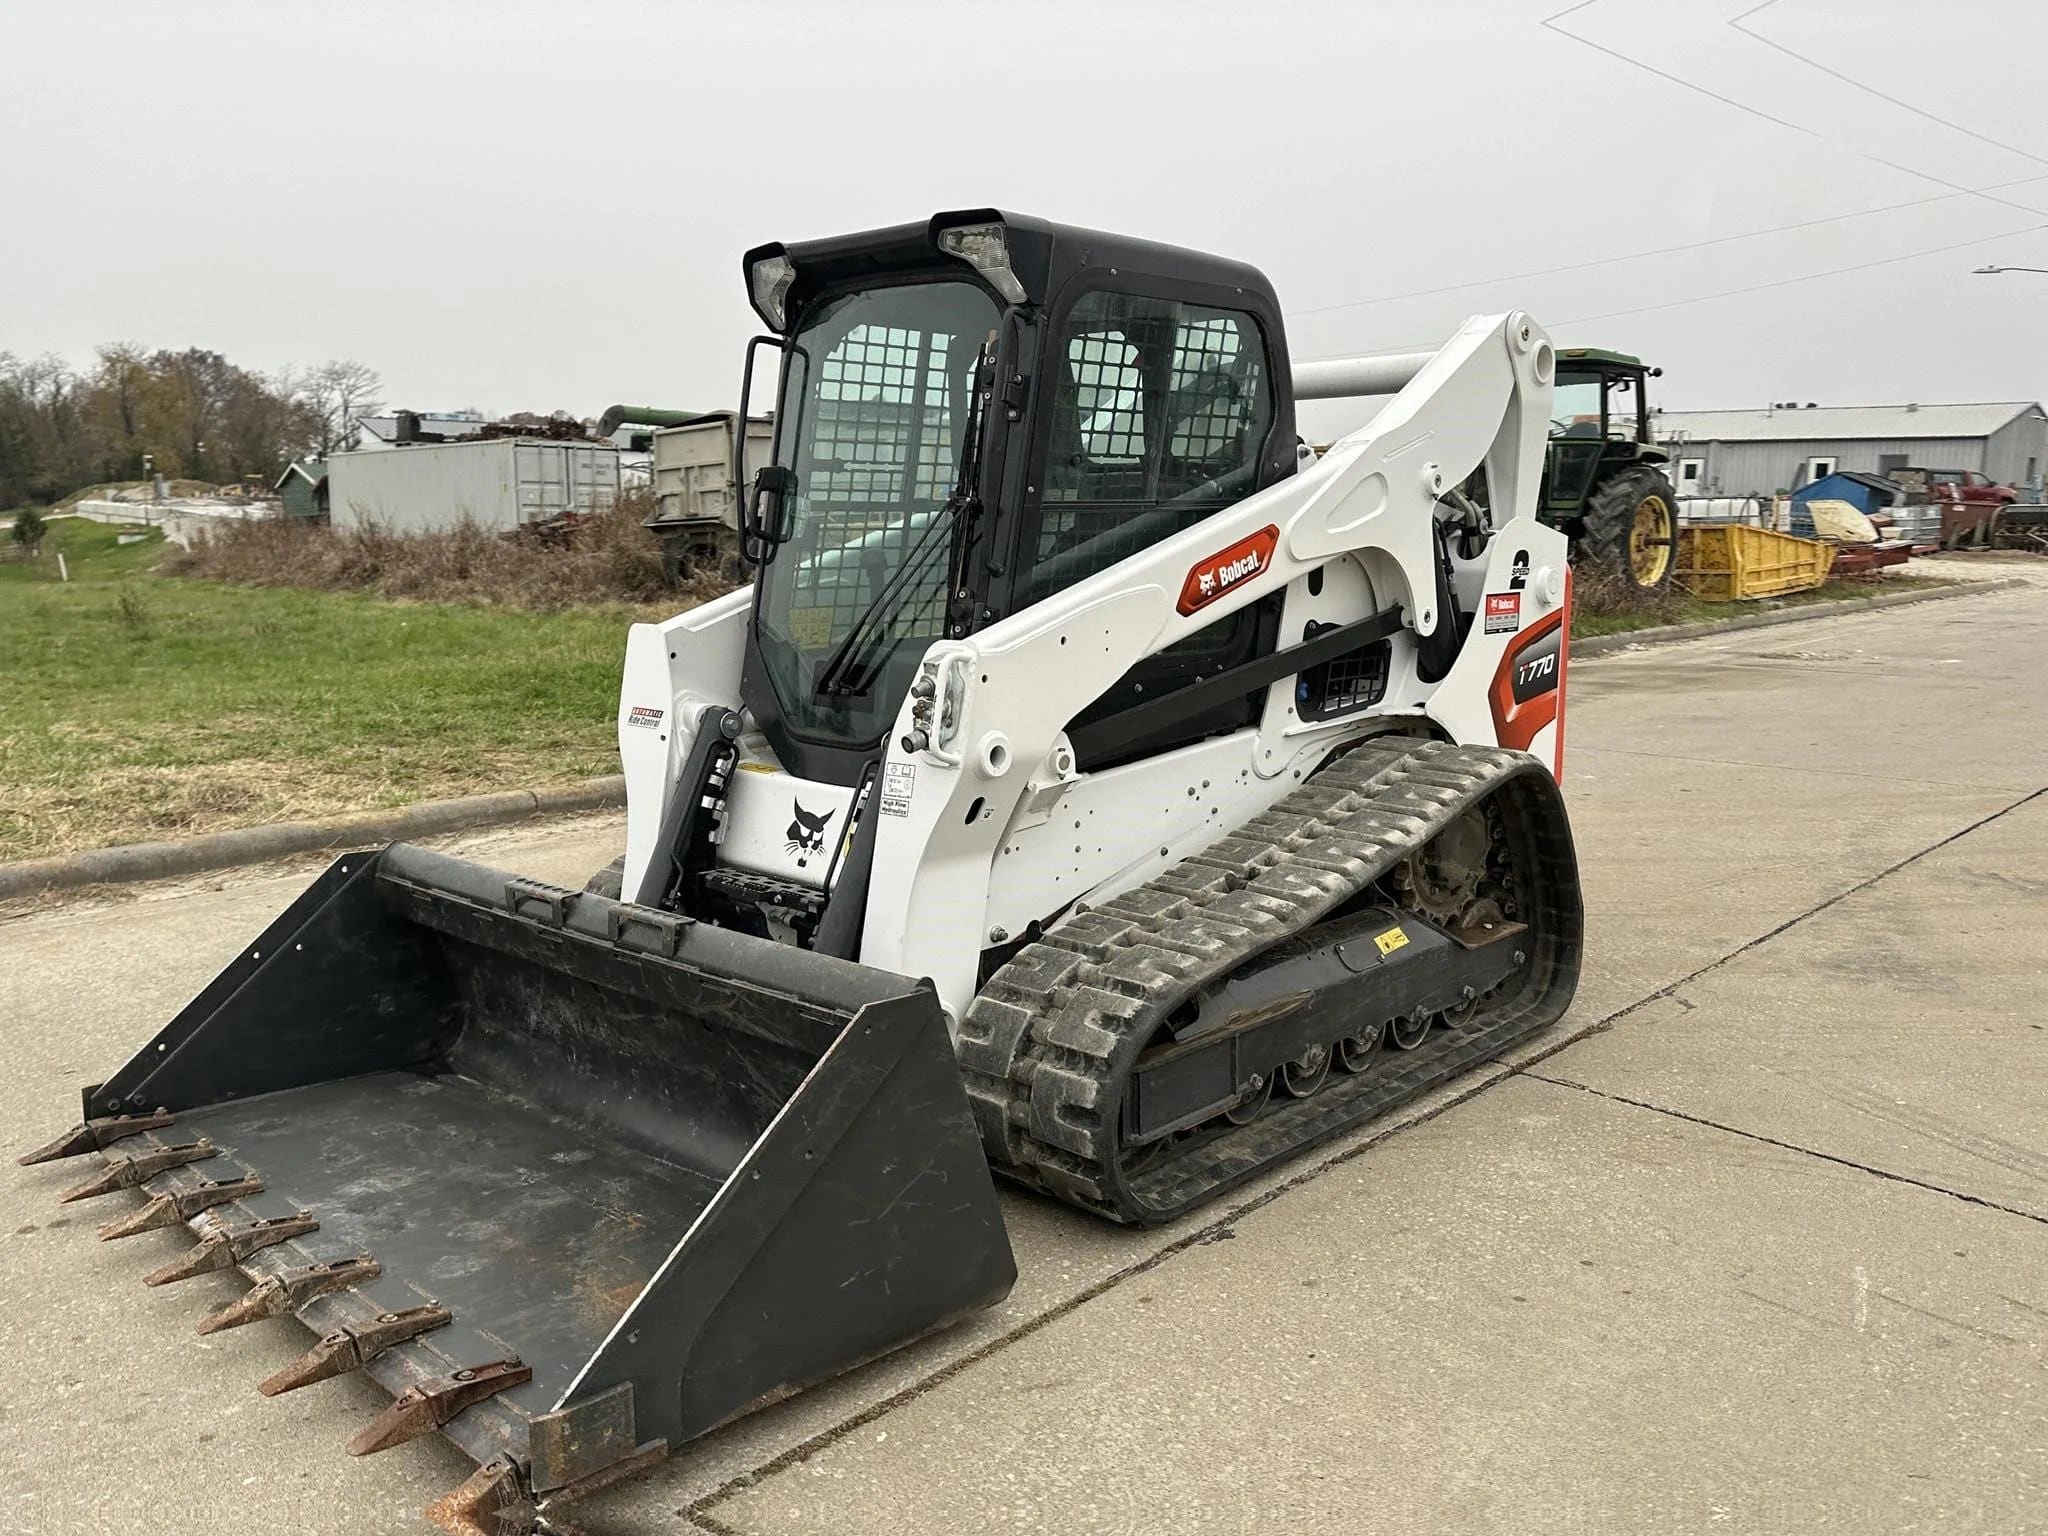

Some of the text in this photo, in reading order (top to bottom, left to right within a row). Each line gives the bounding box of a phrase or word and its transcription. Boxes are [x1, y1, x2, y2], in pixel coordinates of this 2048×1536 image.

[1219, 550, 1259, 587] Bobcat
[1510, 550, 1529, 589] 2
[1511, 567, 1530, 576] SPEED
[640, 717, 660, 728] Control
[882, 807, 907, 815] Hydraulics
